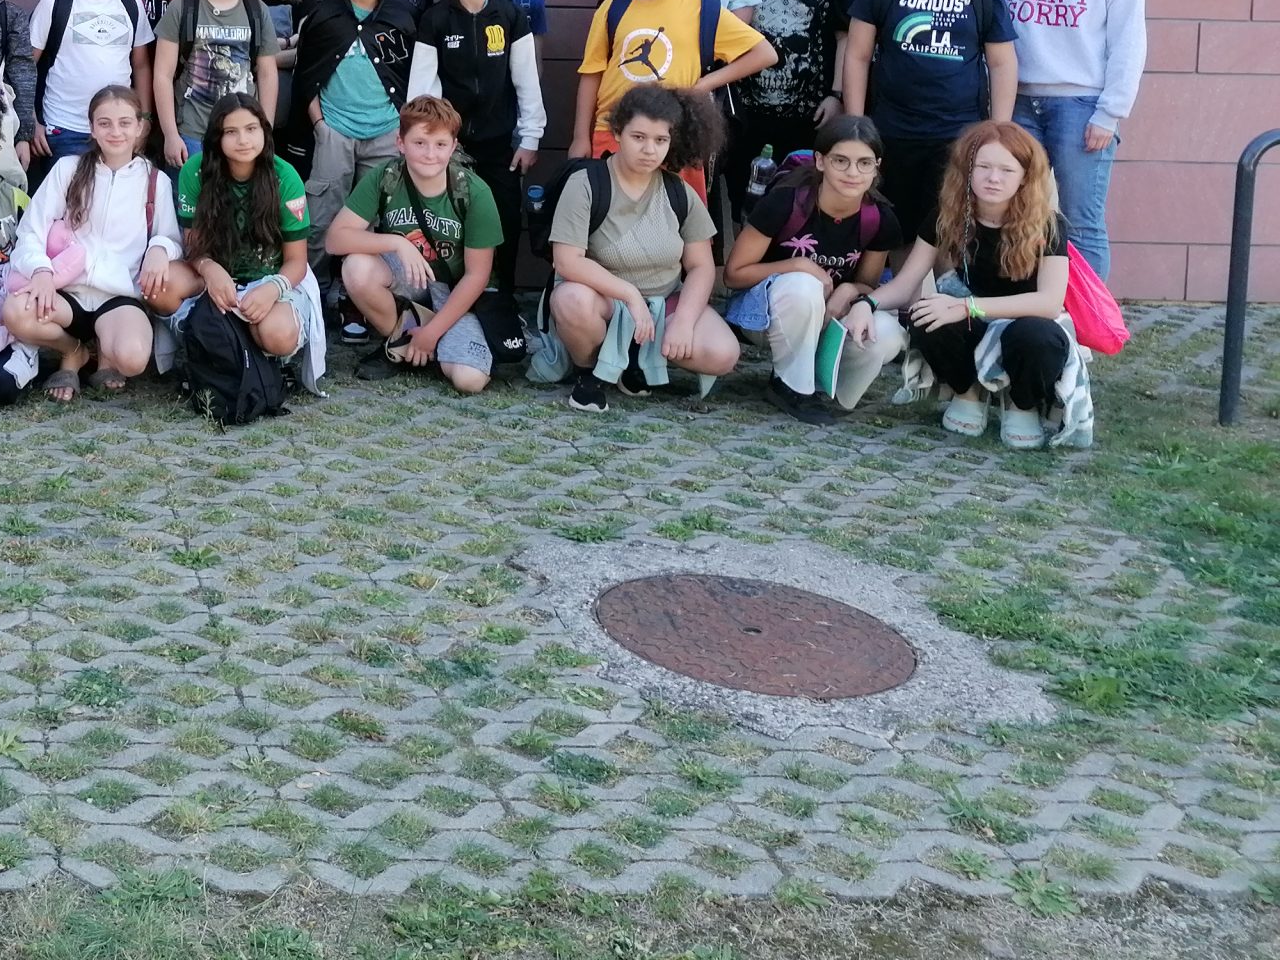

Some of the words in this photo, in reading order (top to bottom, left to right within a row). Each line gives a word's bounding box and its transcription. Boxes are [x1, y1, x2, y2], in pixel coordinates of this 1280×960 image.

[1008, 0, 1087, 28] SORRY
[930, 29, 951, 47] LA
[901, 42, 959, 56] CALIFORNIA
